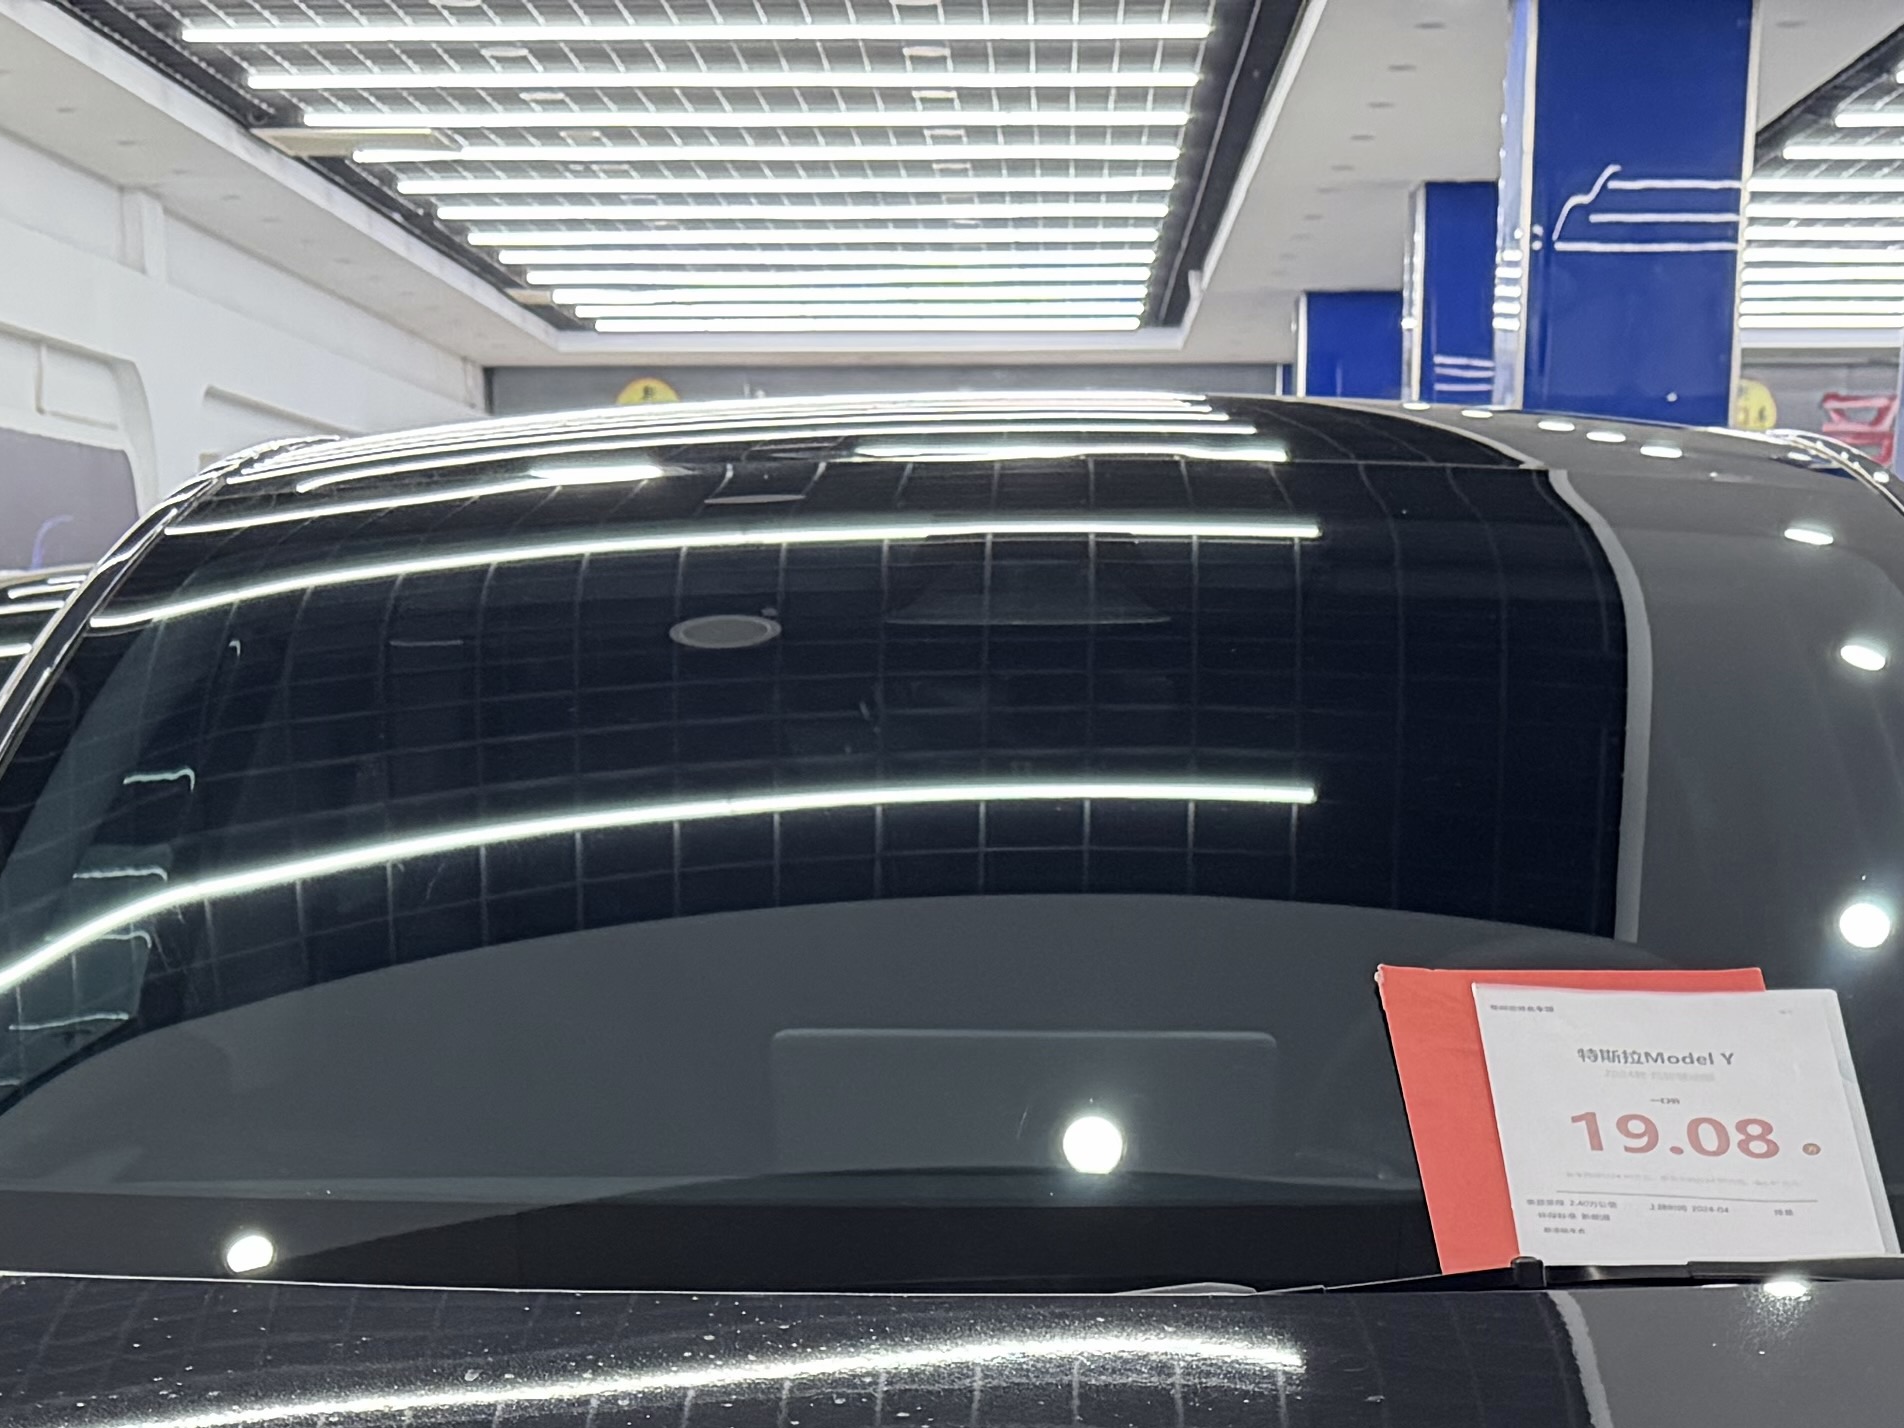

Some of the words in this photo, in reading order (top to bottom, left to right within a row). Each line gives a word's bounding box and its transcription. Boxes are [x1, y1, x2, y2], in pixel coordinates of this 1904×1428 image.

[1577, 1047, 1714, 1066] 特斯拉Model
[1720, 1053, 1734, 1066] Y
[1570, 1111, 1780, 1160] 19.08
